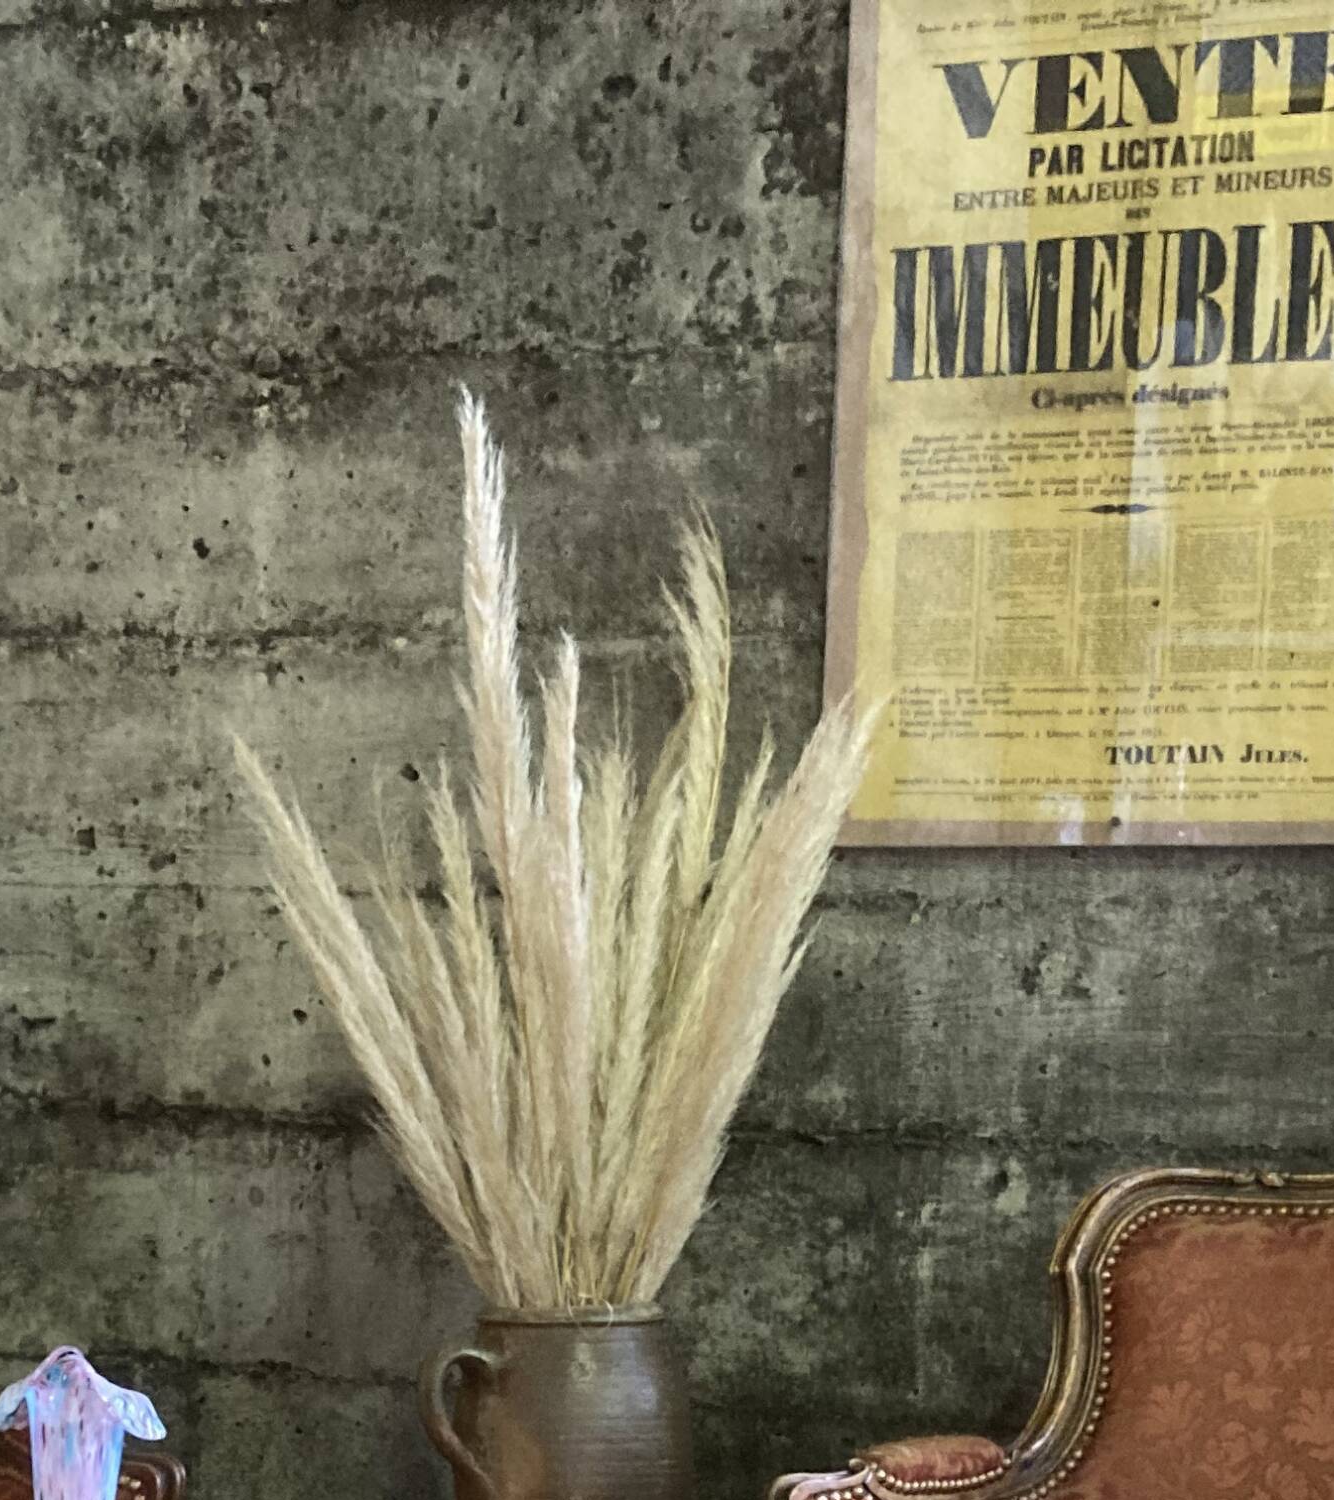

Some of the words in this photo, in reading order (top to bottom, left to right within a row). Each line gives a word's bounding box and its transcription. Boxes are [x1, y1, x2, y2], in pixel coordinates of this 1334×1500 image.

[1028, 143, 1085, 179] PAR
[1101, 130, 1256, 171] LICITATION
[953, 188, 1036, 212] ENTRE
[1046, 176, 1160, 205] MAJEURS
[1172, 176, 1203, 197] ET
[1215, 167, 1334, 195] MINEURS
[1105, 743, 1226, 767] TOUTAIN
